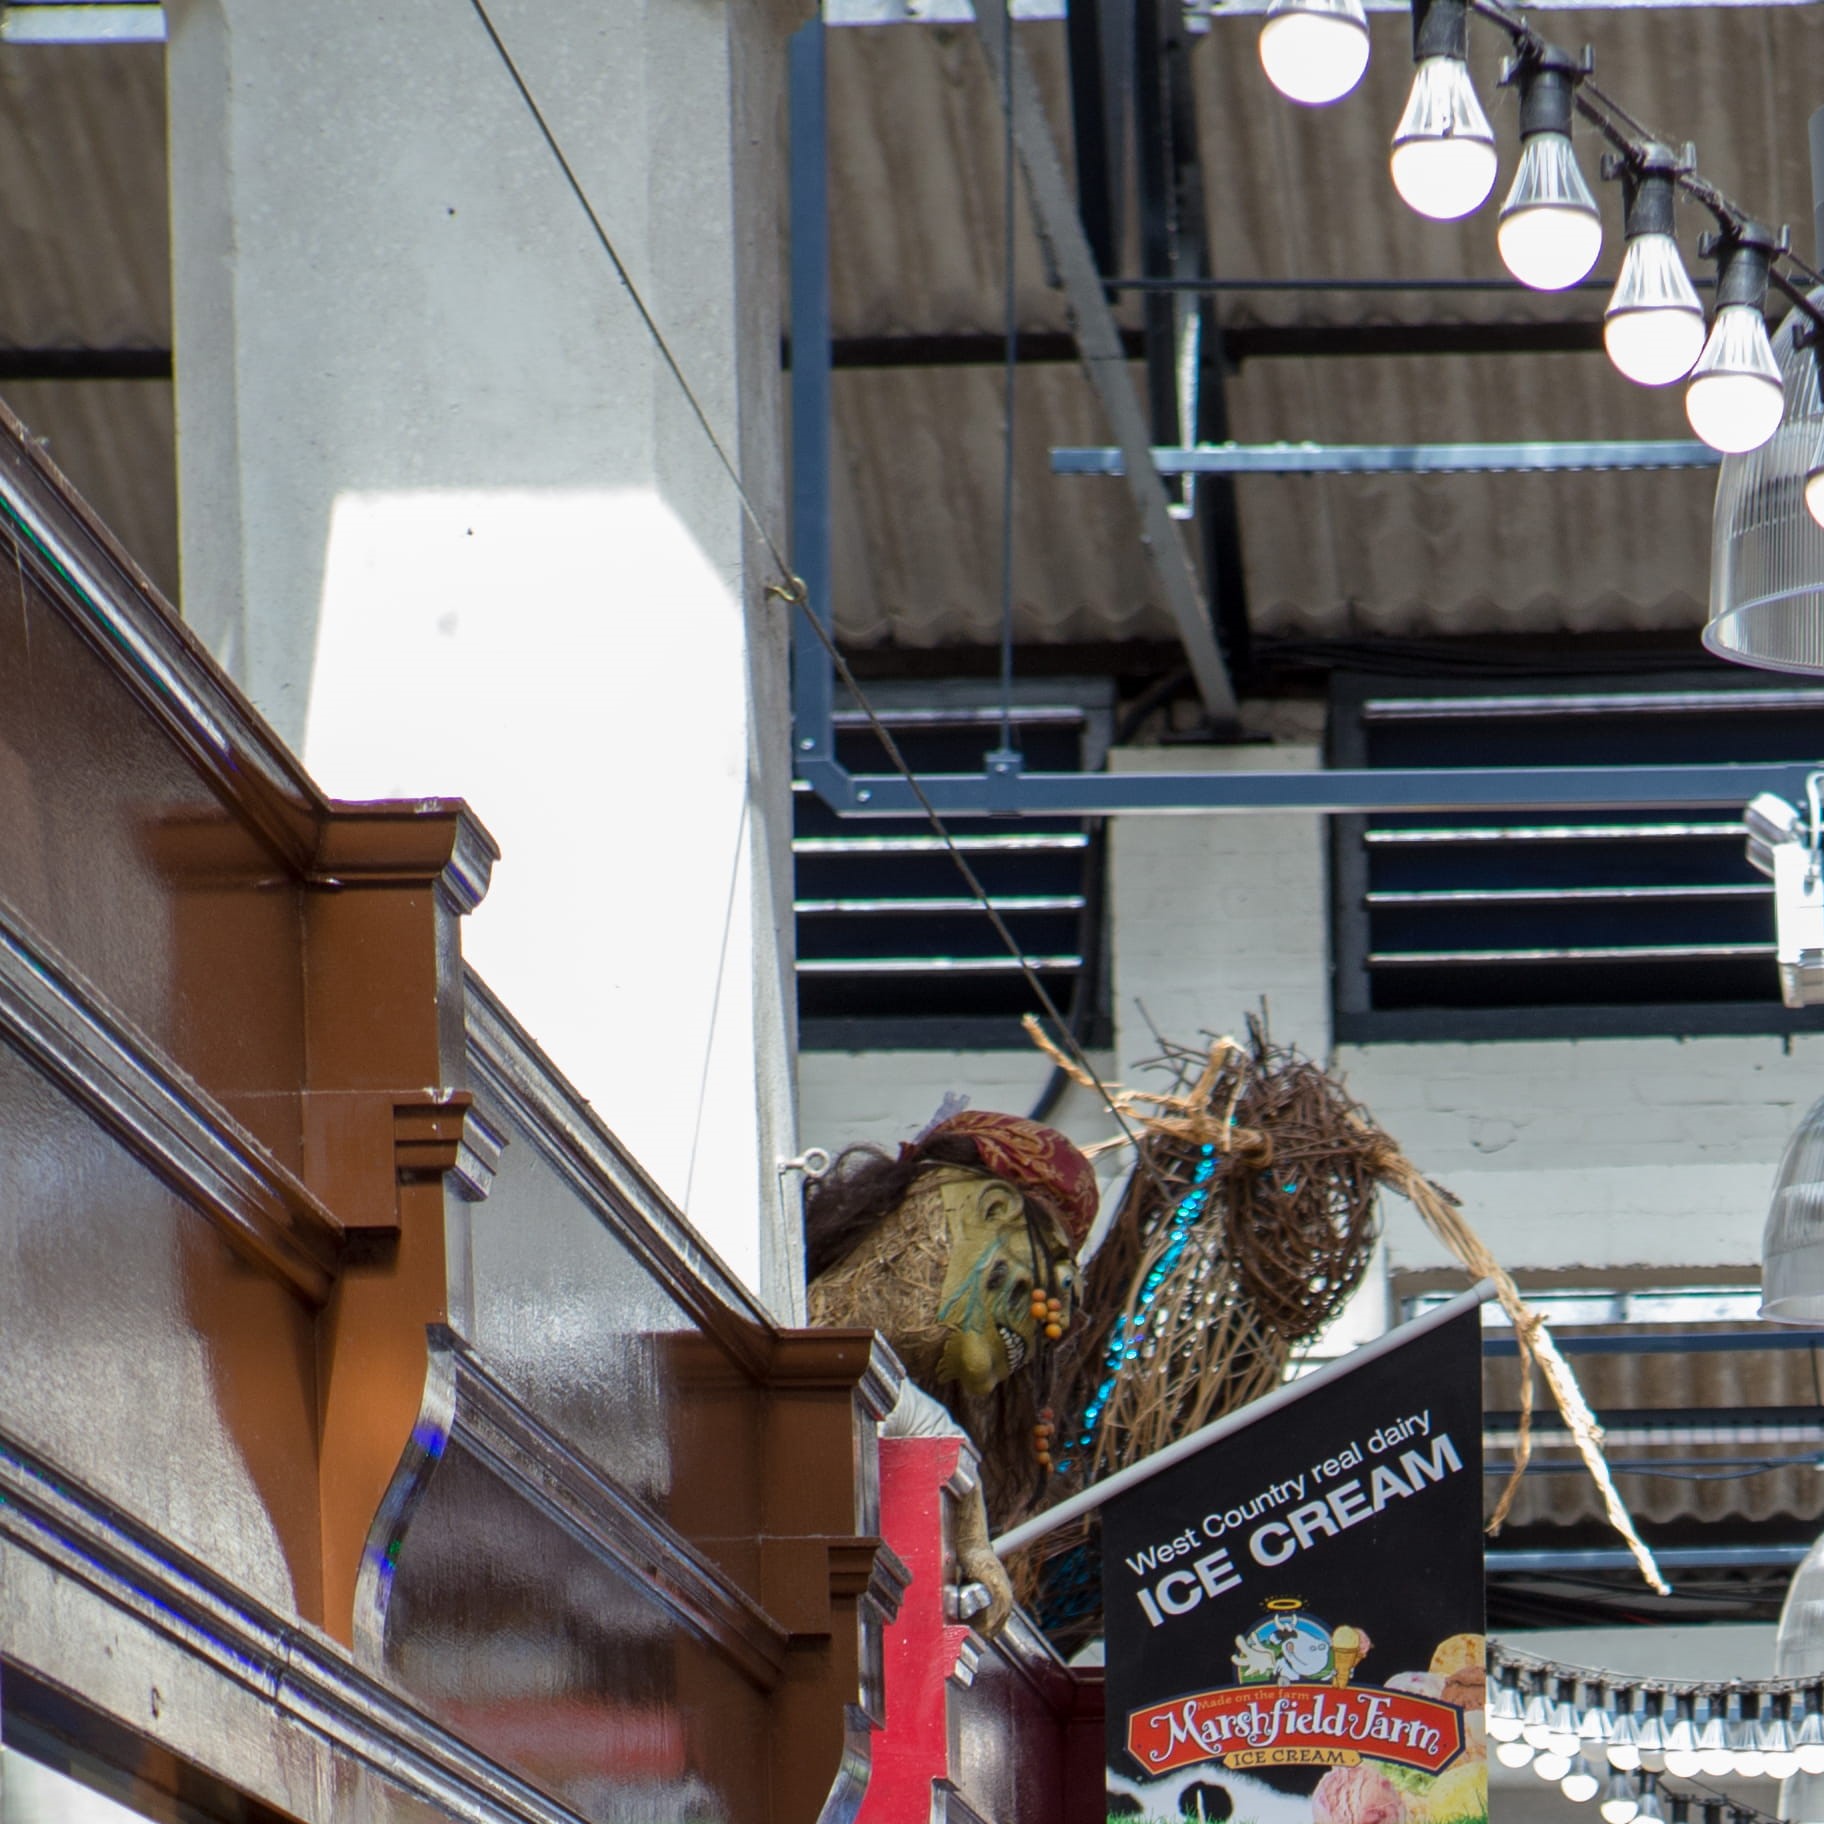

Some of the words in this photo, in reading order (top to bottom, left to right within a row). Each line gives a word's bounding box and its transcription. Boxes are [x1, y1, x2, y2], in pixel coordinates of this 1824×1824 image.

[1125, 1527, 1201, 1577] West
[1202, 1473, 1307, 1538] Country
[1311, 1442, 1364, 1484] real
[1367, 1409, 1432, 1454] dairy
[1136, 1547, 1243, 1628] ICE
[1249, 1433, 1464, 1567] CREAM
[1149, 1694, 1347, 1763] Marshfield
[1348, 1693, 1441, 1755] Farm
[1196, 1695, 1232, 1711] Made
[1234, 1692, 1251, 1703] on
[1253, 1688, 1276, 1701] the
[1278, 1690, 1309, 1702] farm
[1232, 1751, 1269, 1767] ICE
[1271, 1749, 1346, 1767] CREAM
